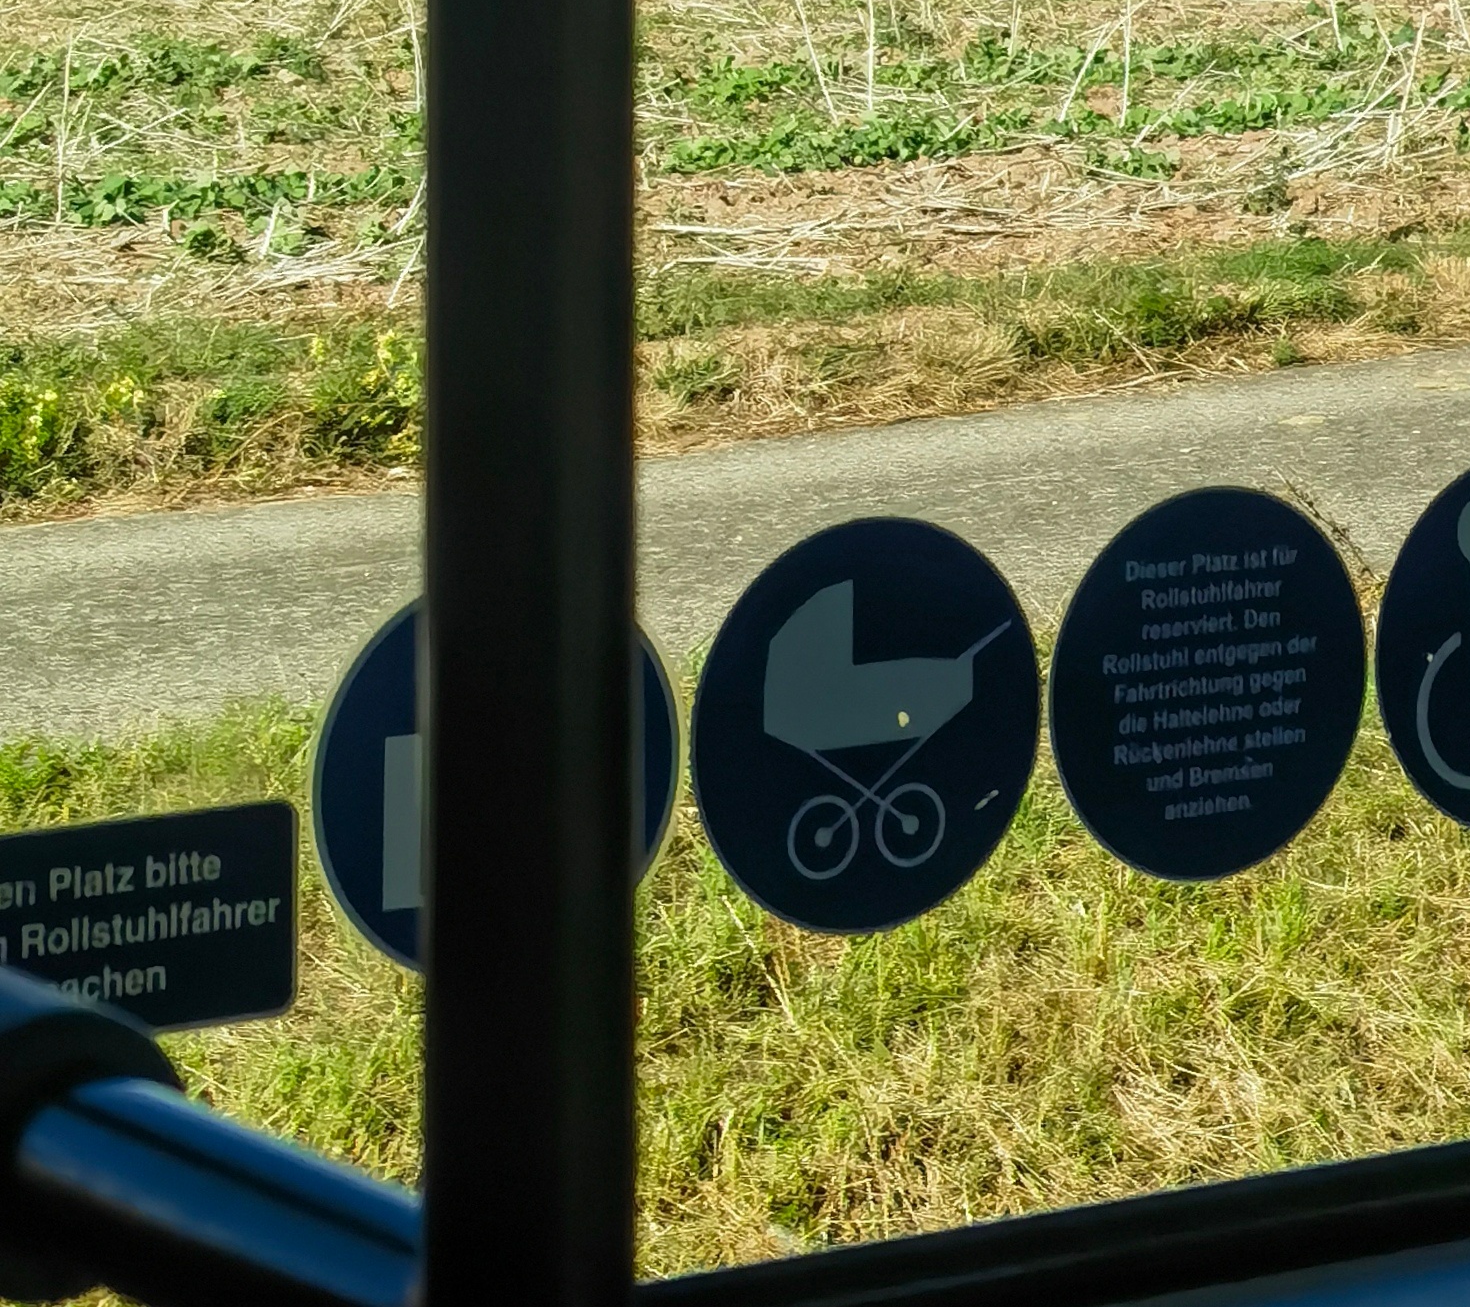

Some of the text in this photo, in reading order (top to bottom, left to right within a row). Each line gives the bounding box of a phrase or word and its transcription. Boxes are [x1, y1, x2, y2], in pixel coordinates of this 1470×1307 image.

[1192, 553, 1239, 575] Platz
[1244, 549, 1267, 569] ist
[1272, 545, 1298, 566] für
[1141, 579, 1283, 610] Rollstuhlfahrer
[1244, 608, 1281, 629] Den
[1102, 634, 1318, 675] Rollstuhl entgegen der
[1114, 667, 1306, 704] Fahrtrichtung gegen
[1119, 695, 1302, 734] die Haltelehne oder
[1244, 726, 1306, 750] stellen
[1146, 761, 1273, 792] und Bremsen
[49, 862, 135, 902] Platz
[145, 851, 222, 889] bitte
[21, 897, 281, 959] Rollstuhlfahrer
